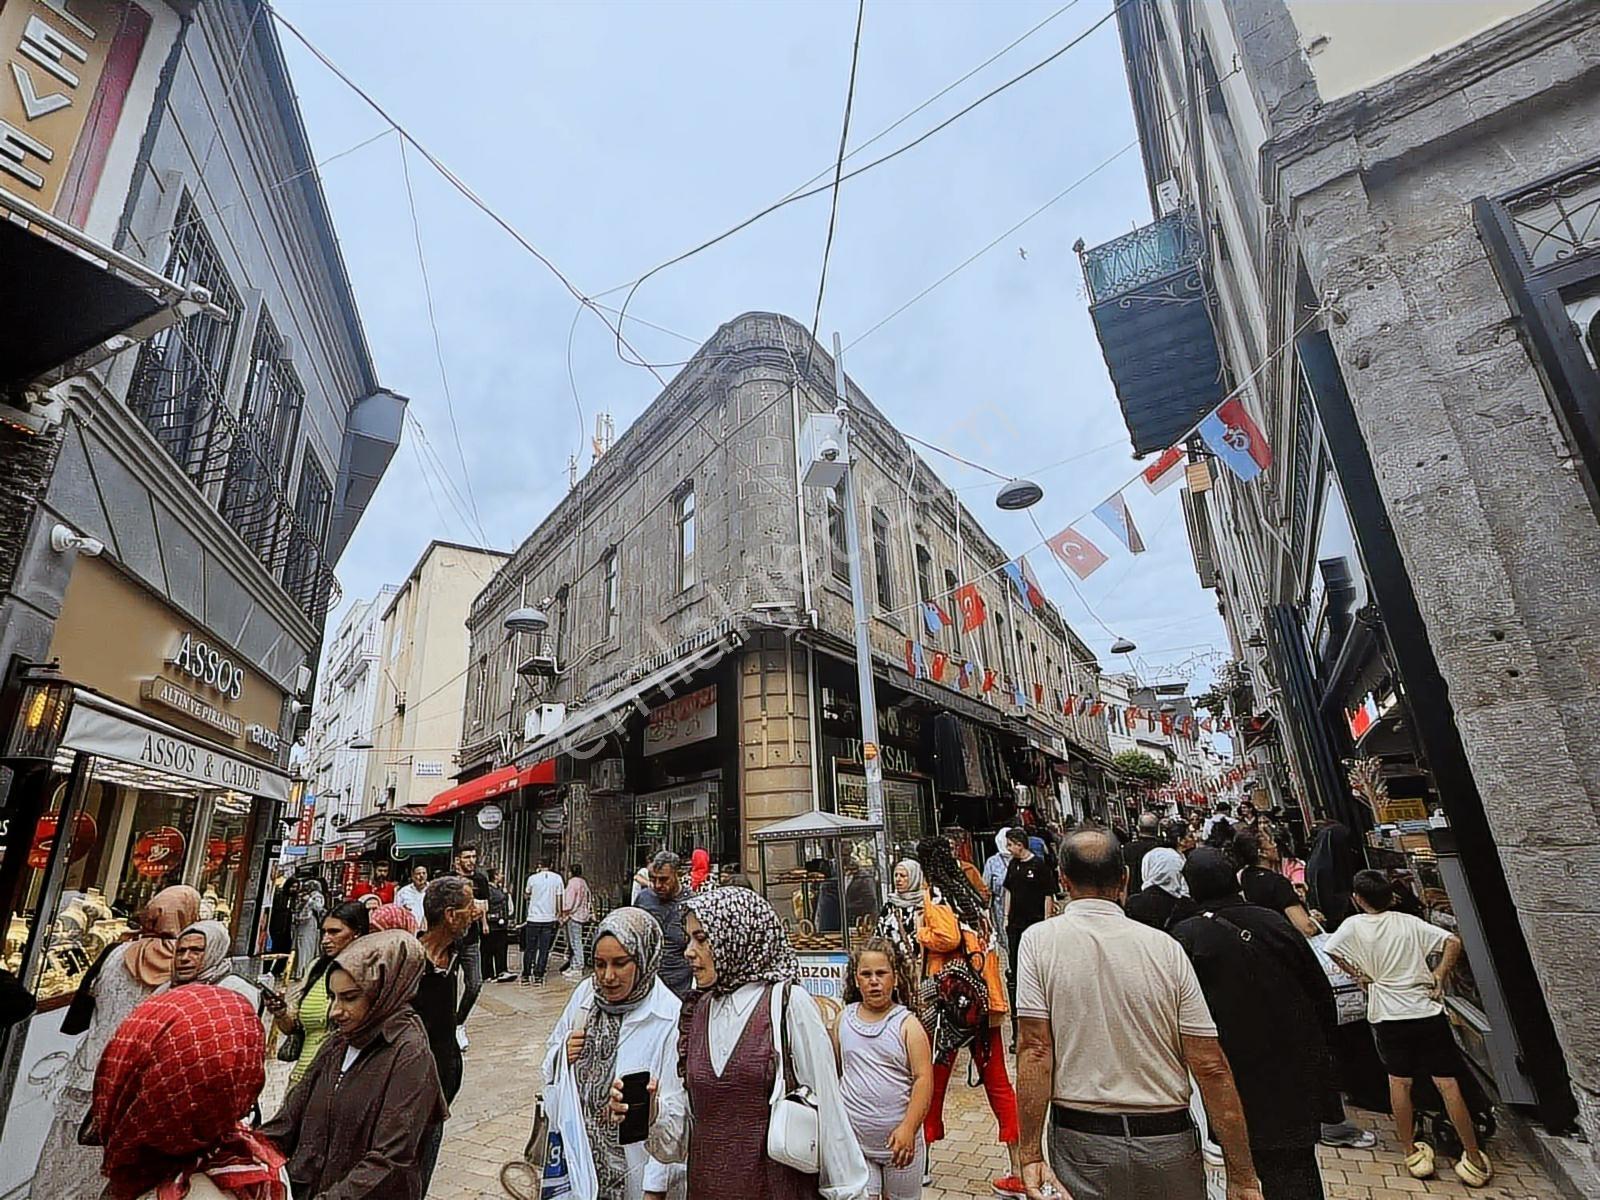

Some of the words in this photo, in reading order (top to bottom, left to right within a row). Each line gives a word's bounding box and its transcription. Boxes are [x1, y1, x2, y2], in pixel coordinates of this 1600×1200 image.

[173, 632, 245, 700] ASSOS
[140, 735, 197, 773] ASSOS
[204, 754, 214, 778] &
[221, 760, 262, 791] CADDE
[797, 966, 841, 978] BZON
